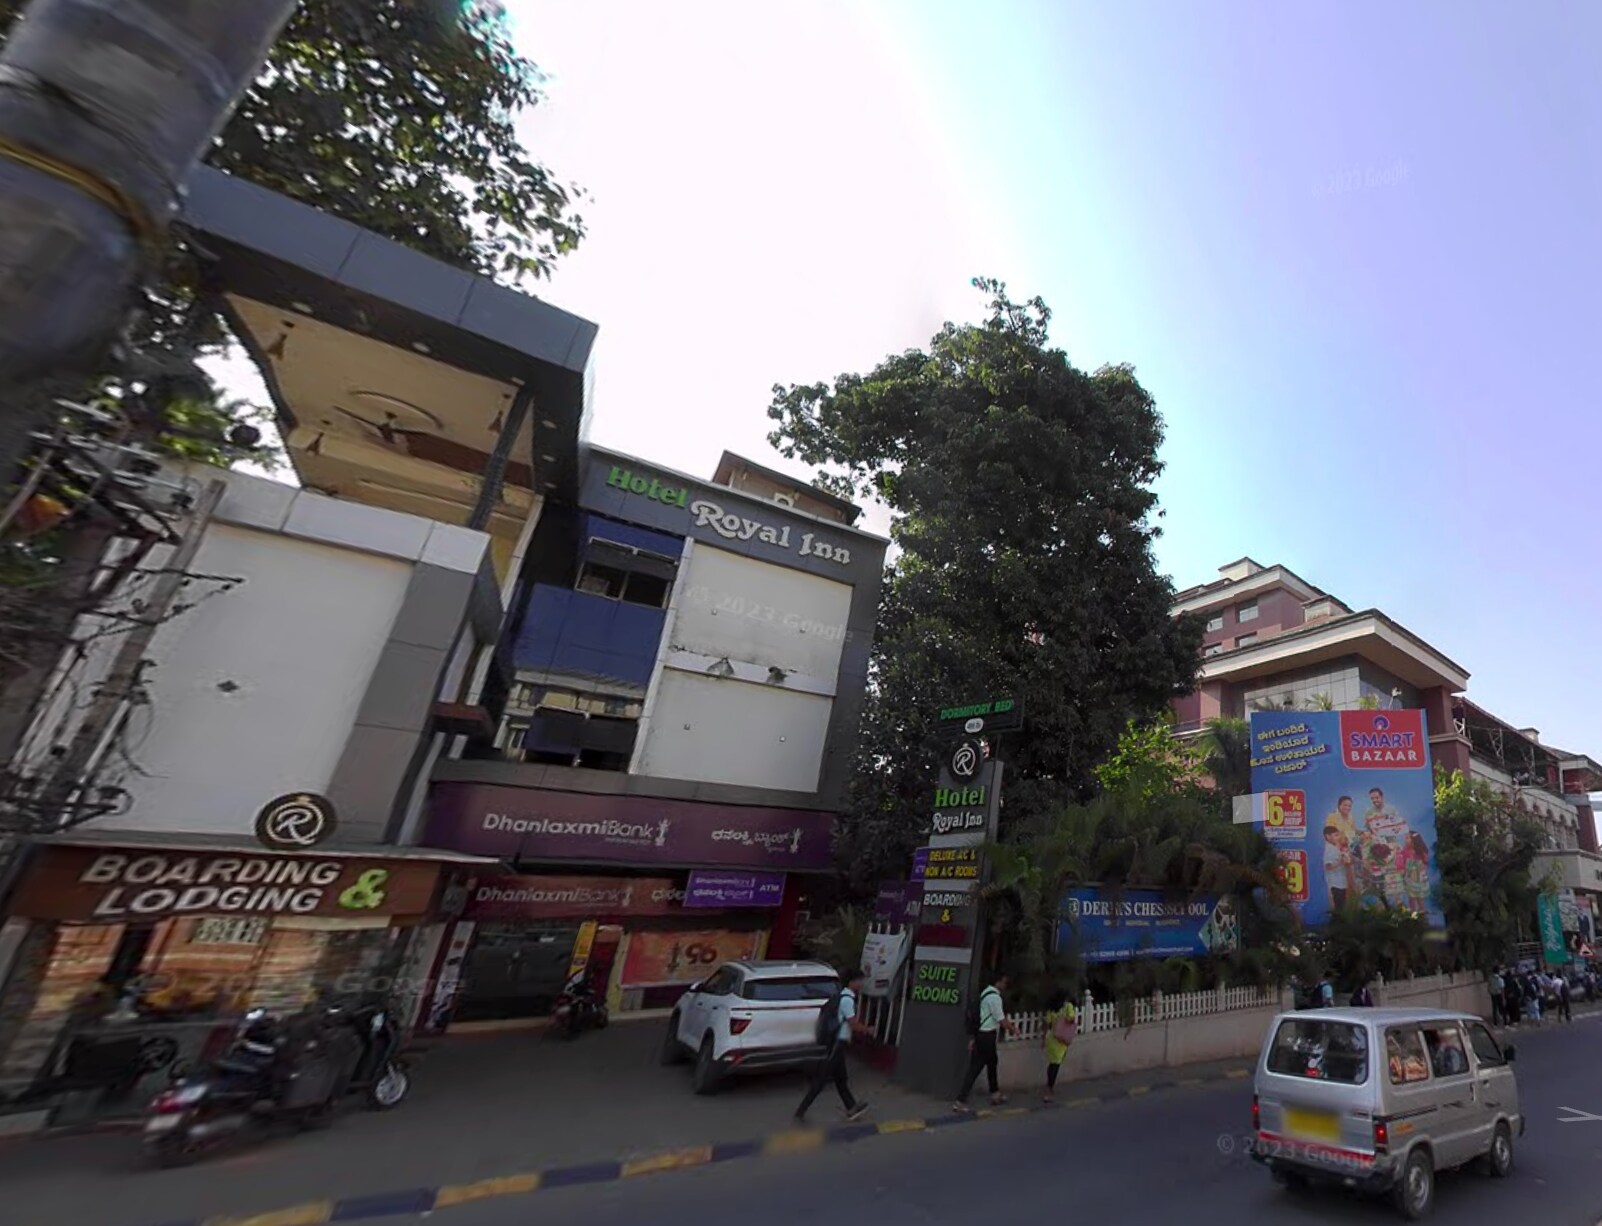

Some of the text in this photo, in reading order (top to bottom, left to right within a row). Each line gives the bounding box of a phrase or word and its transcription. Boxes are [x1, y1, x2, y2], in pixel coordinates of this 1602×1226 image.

[606, 466, 689, 508] Hotel
[690, 500, 850, 564] Royal Inn
[940, 699, 1012, 720] DORMITORY BED
[1350, 732, 1414, 748] SMART
[1351, 750, 1418, 762] BAZAAR
[934, 785, 985, 808] Hotel
[931, 811, 983, 834] Royal Inn
[929, 850, 956, 861] DELUXE
[924, 866, 938, 877] NON
[955, 865, 977, 877] ROOMS
[79, 854, 389, 909] BOARDING &
[759, 883, 781, 893] ATM
[93, 886, 324, 915] LODGING
[923, 893, 971, 906] BOARDING
[941, 909, 950, 923] &
[918, 965, 956, 982] SUITE
[912, 984, 959, 1003] ROOMS
